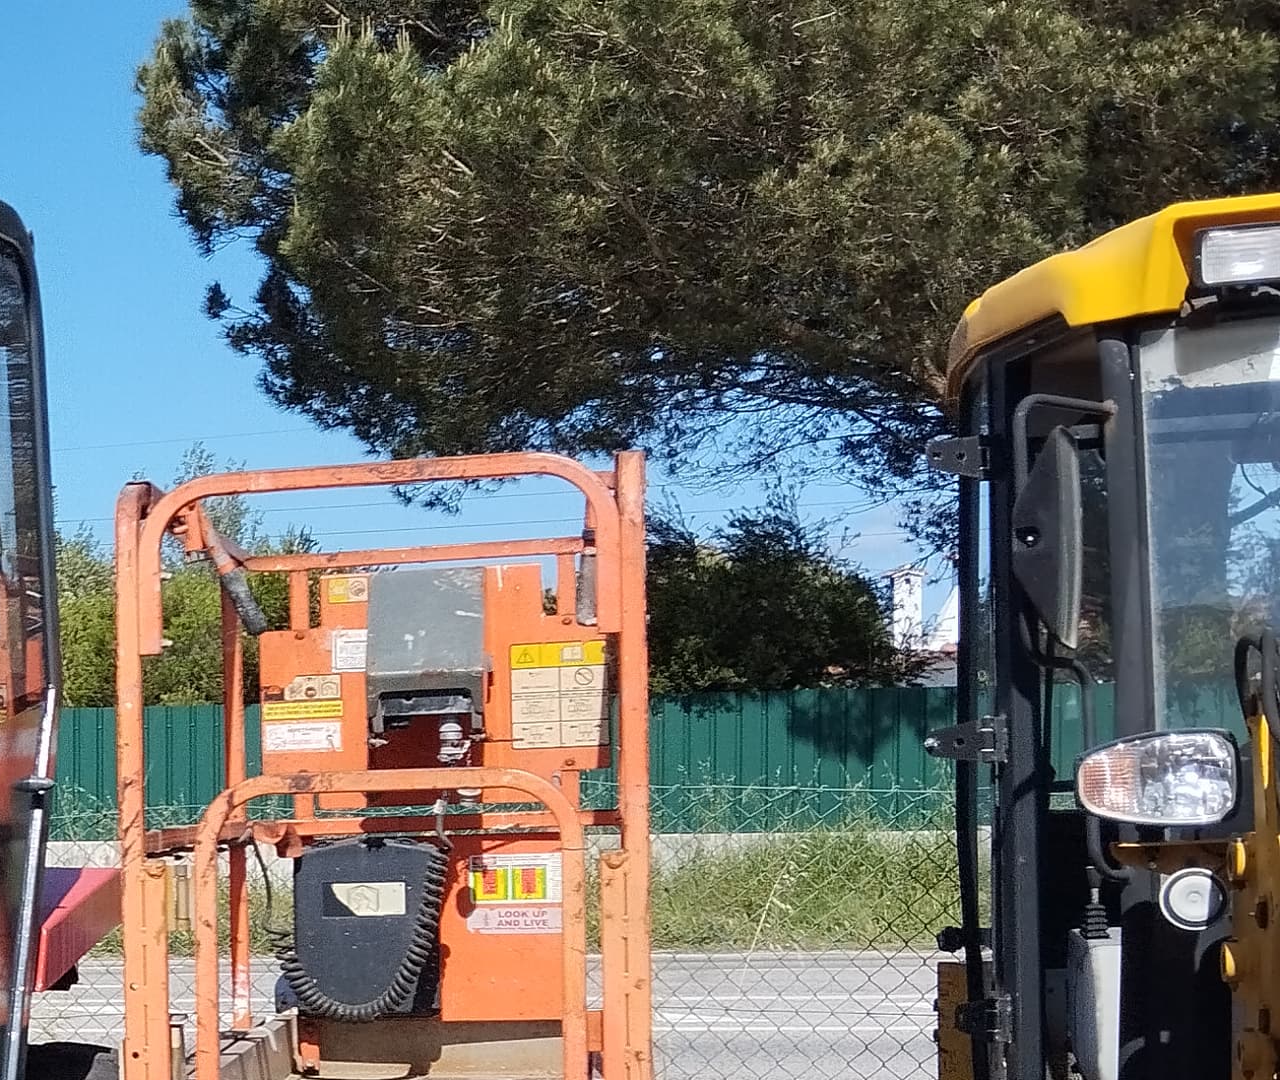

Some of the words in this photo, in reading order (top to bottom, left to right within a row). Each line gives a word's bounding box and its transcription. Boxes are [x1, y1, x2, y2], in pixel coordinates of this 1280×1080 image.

[497, 910, 529, 919] LOOK
[532, 910, 549, 918] UP
[497, 919, 521, 927] AND
[524, 919, 549, 927] LIVE
